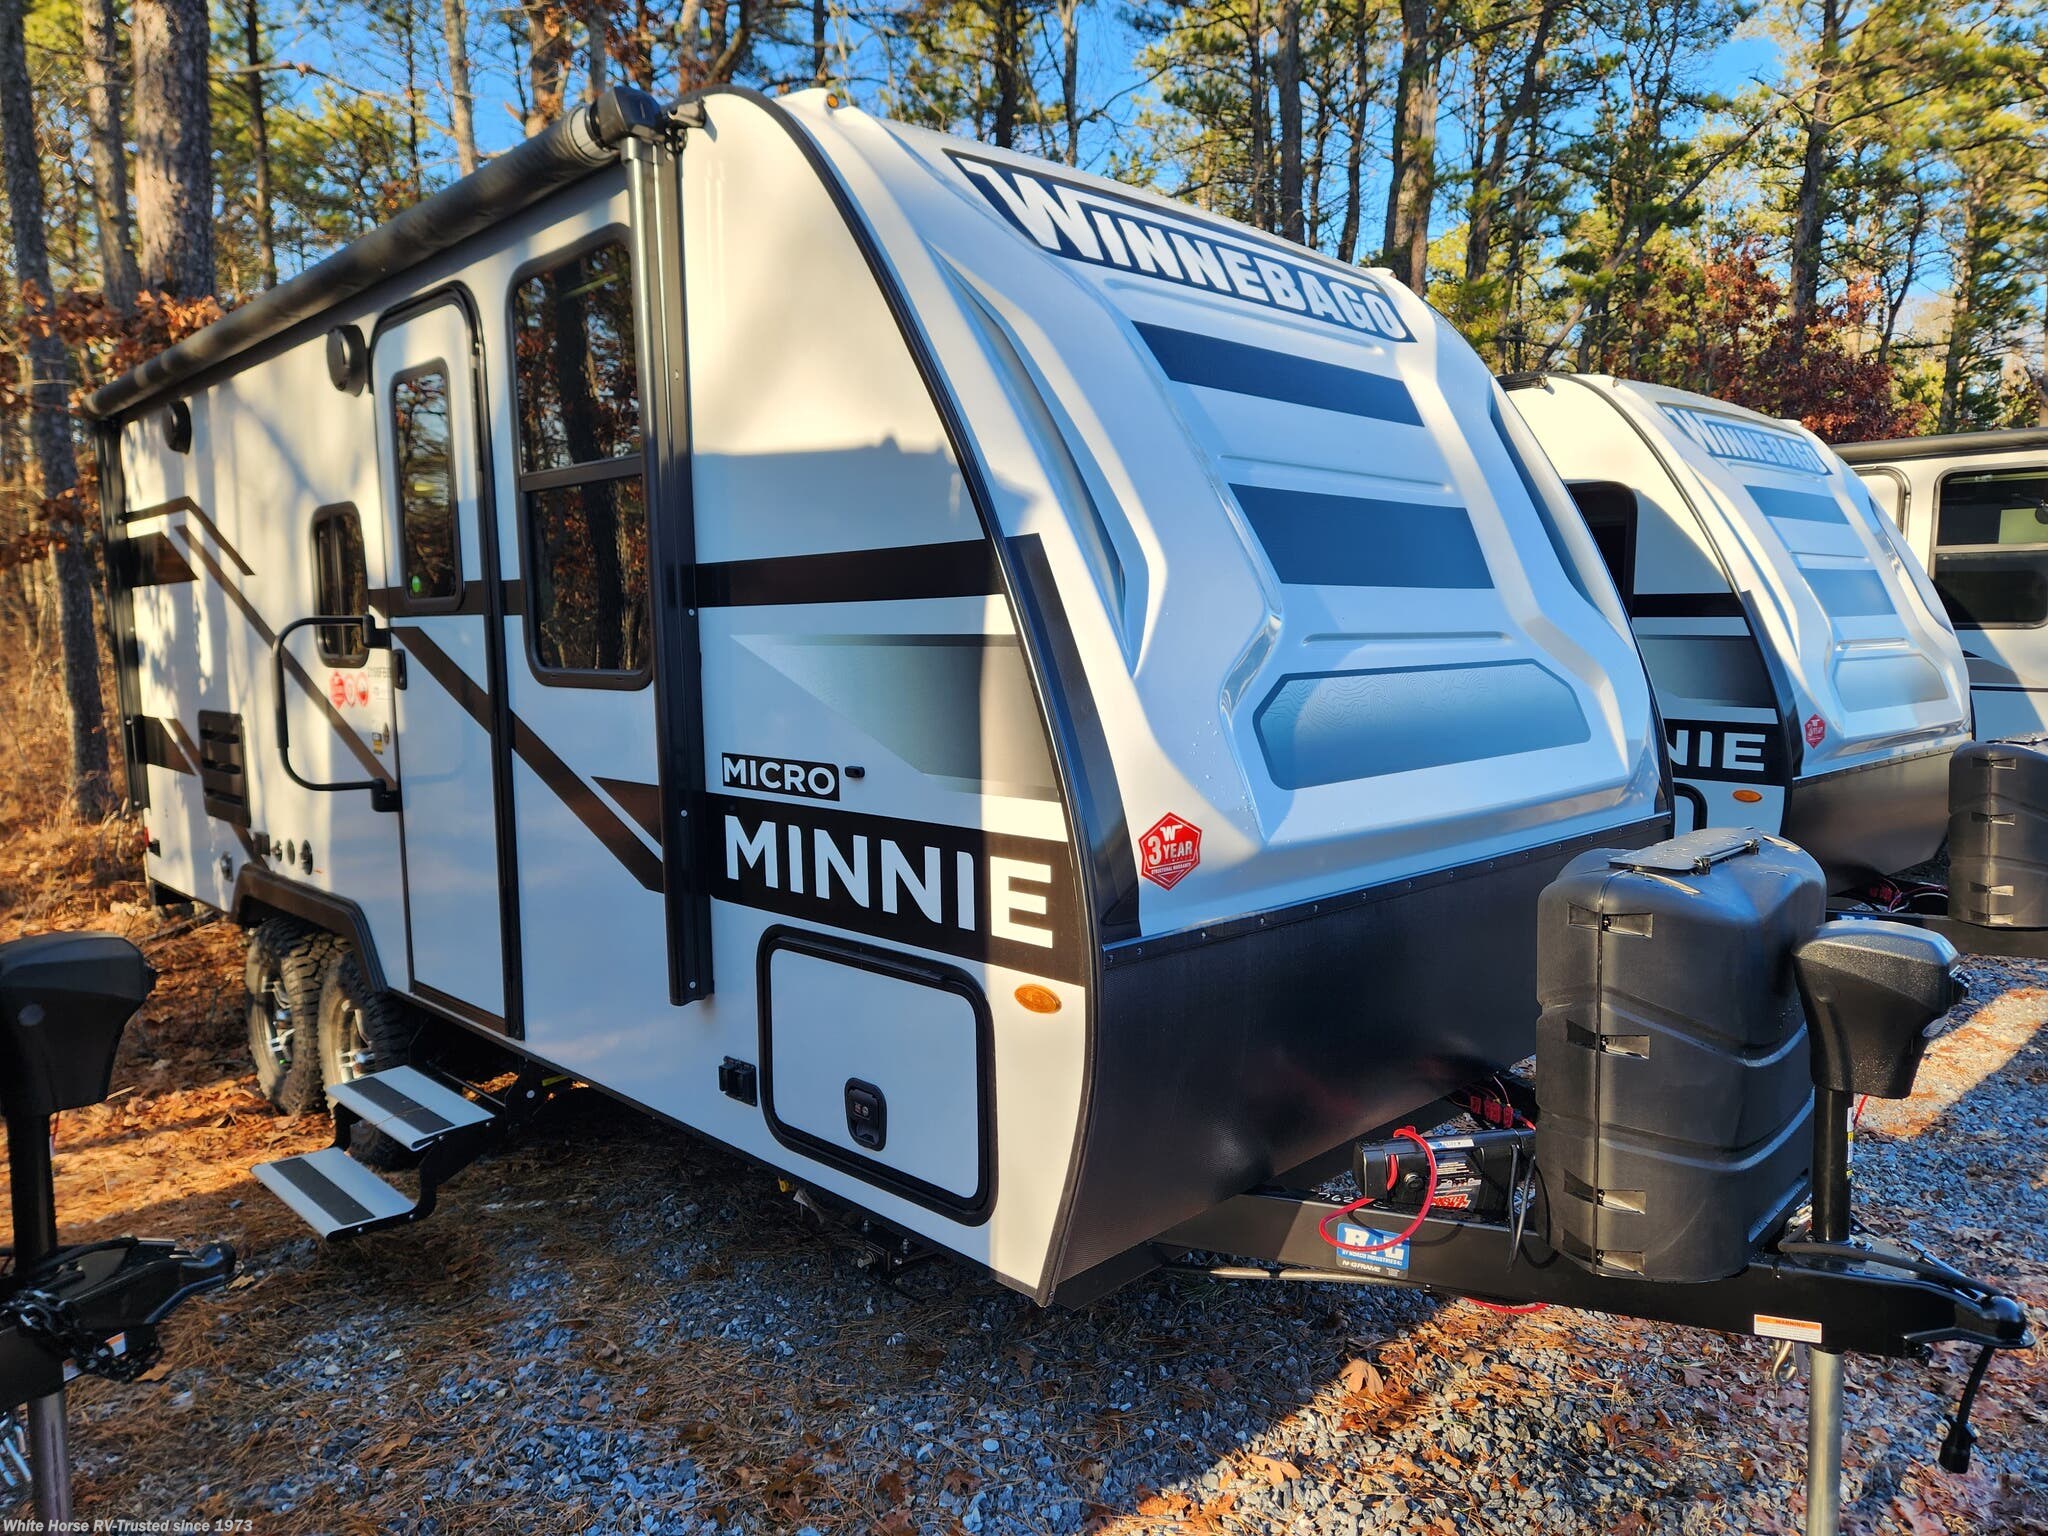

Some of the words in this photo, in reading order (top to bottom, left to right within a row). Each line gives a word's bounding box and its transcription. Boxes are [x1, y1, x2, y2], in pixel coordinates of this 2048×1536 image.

[956, 157, 1405, 340] WINNEBAGO
[1662, 404, 1828, 475] WINNEBAGO
[723, 757, 836, 796] MICRO
[724, 814, 1053, 949] MINNIE
[1147, 835, 1162, 865] 3
[1162, 840, 1193, 860] YEAR
